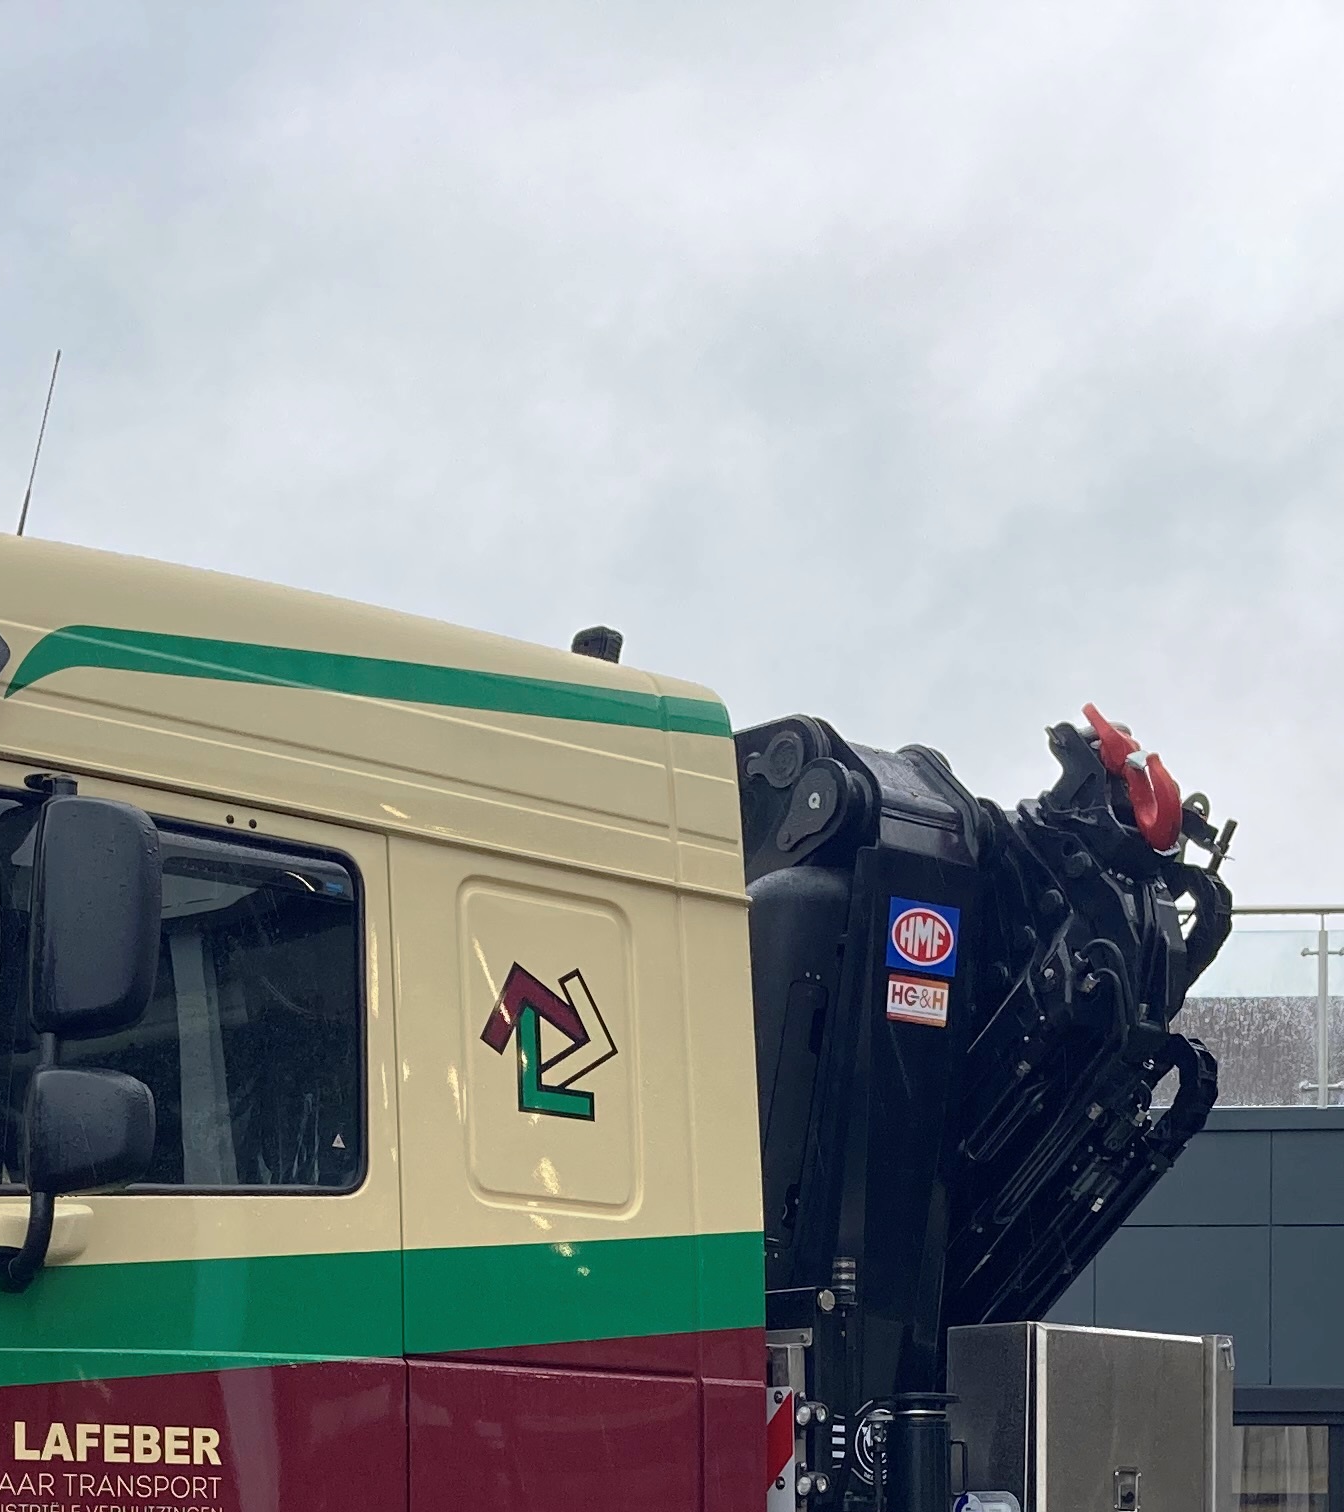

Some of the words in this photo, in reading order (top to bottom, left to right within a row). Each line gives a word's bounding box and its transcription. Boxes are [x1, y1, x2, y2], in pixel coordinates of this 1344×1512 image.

[899, 915, 946, 959] HMF
[14, 1421, 222, 1466] LAFEBER
[62, 1473, 223, 1499] TRANSPORT
